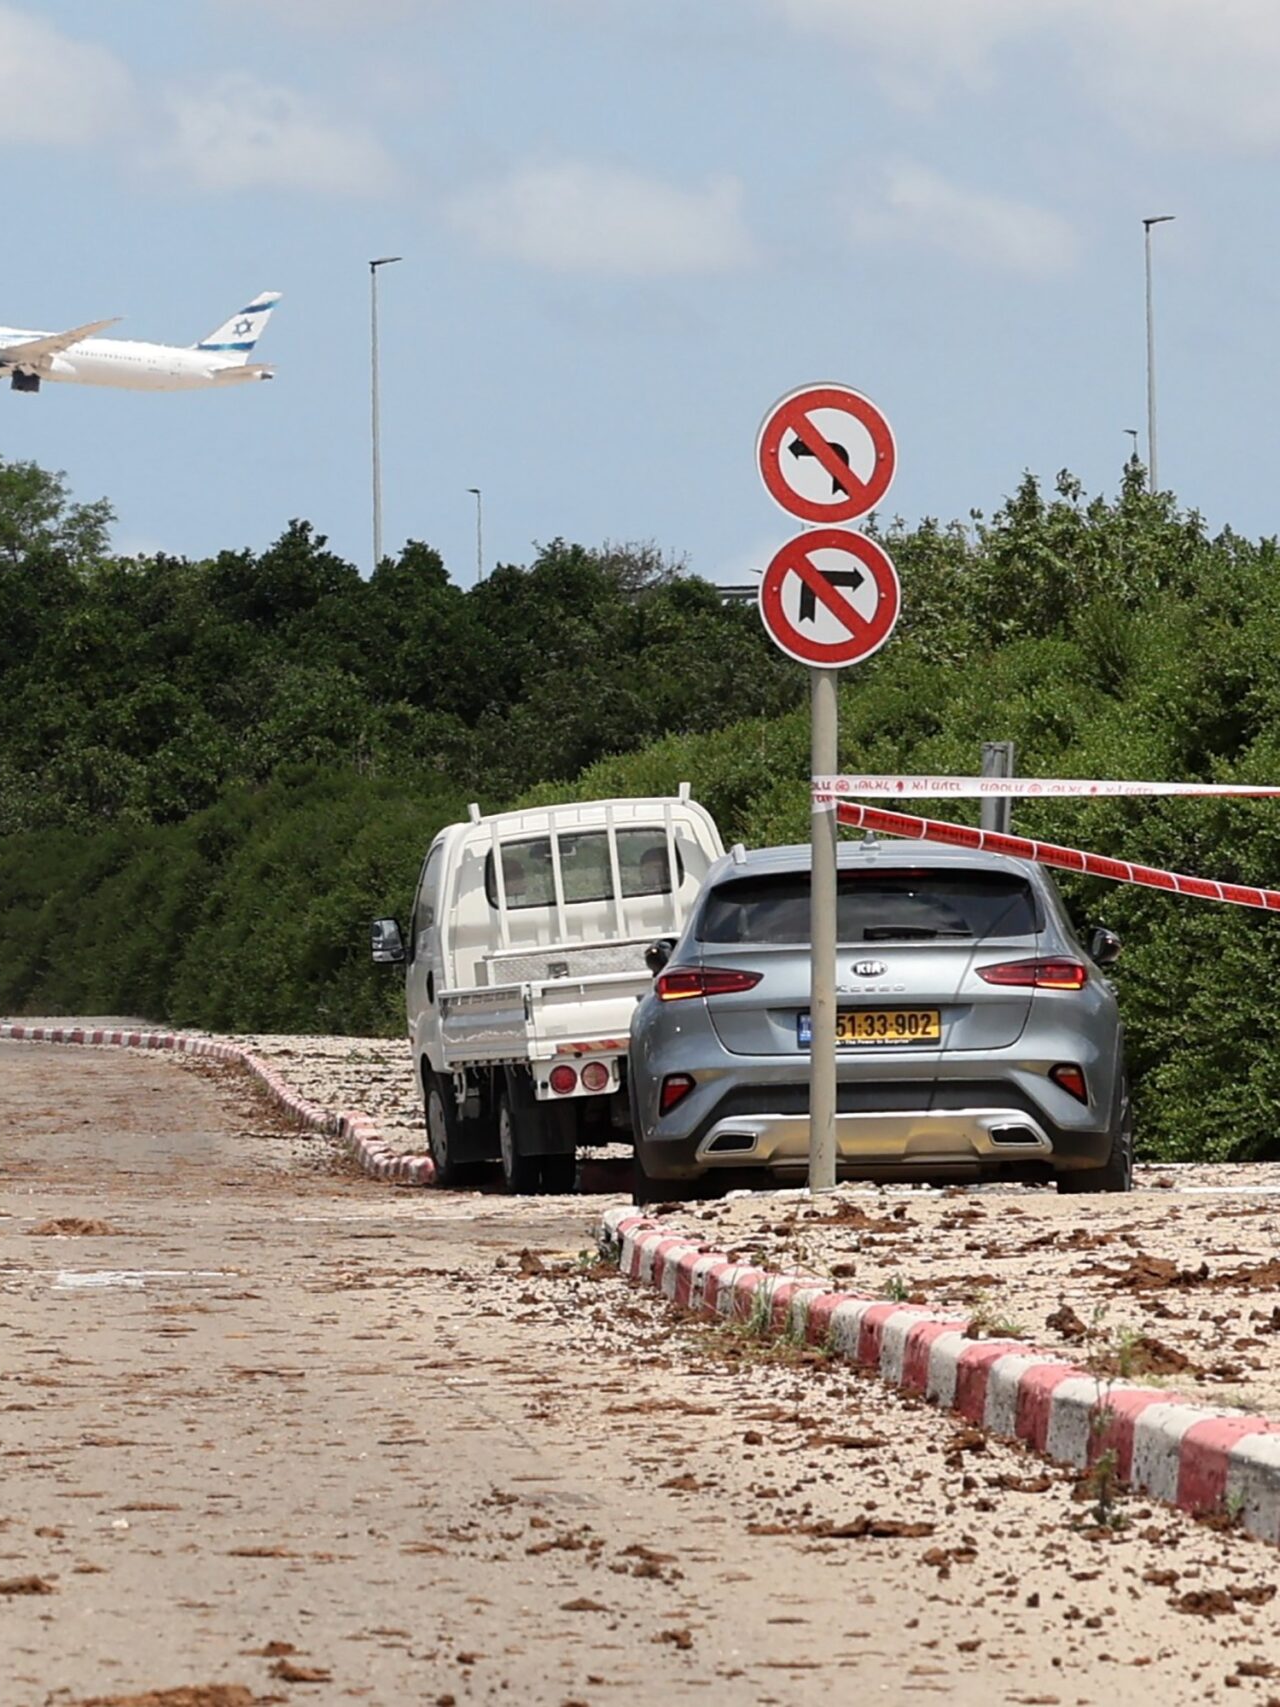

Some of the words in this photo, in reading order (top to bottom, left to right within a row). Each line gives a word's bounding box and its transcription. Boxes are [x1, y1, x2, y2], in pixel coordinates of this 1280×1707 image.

[855, 780, 890, 792] ישראל
[911, 780, 929, 791] אין
[931, 781, 962, 791] מעבר
[856, 962, 882, 974] KIA
